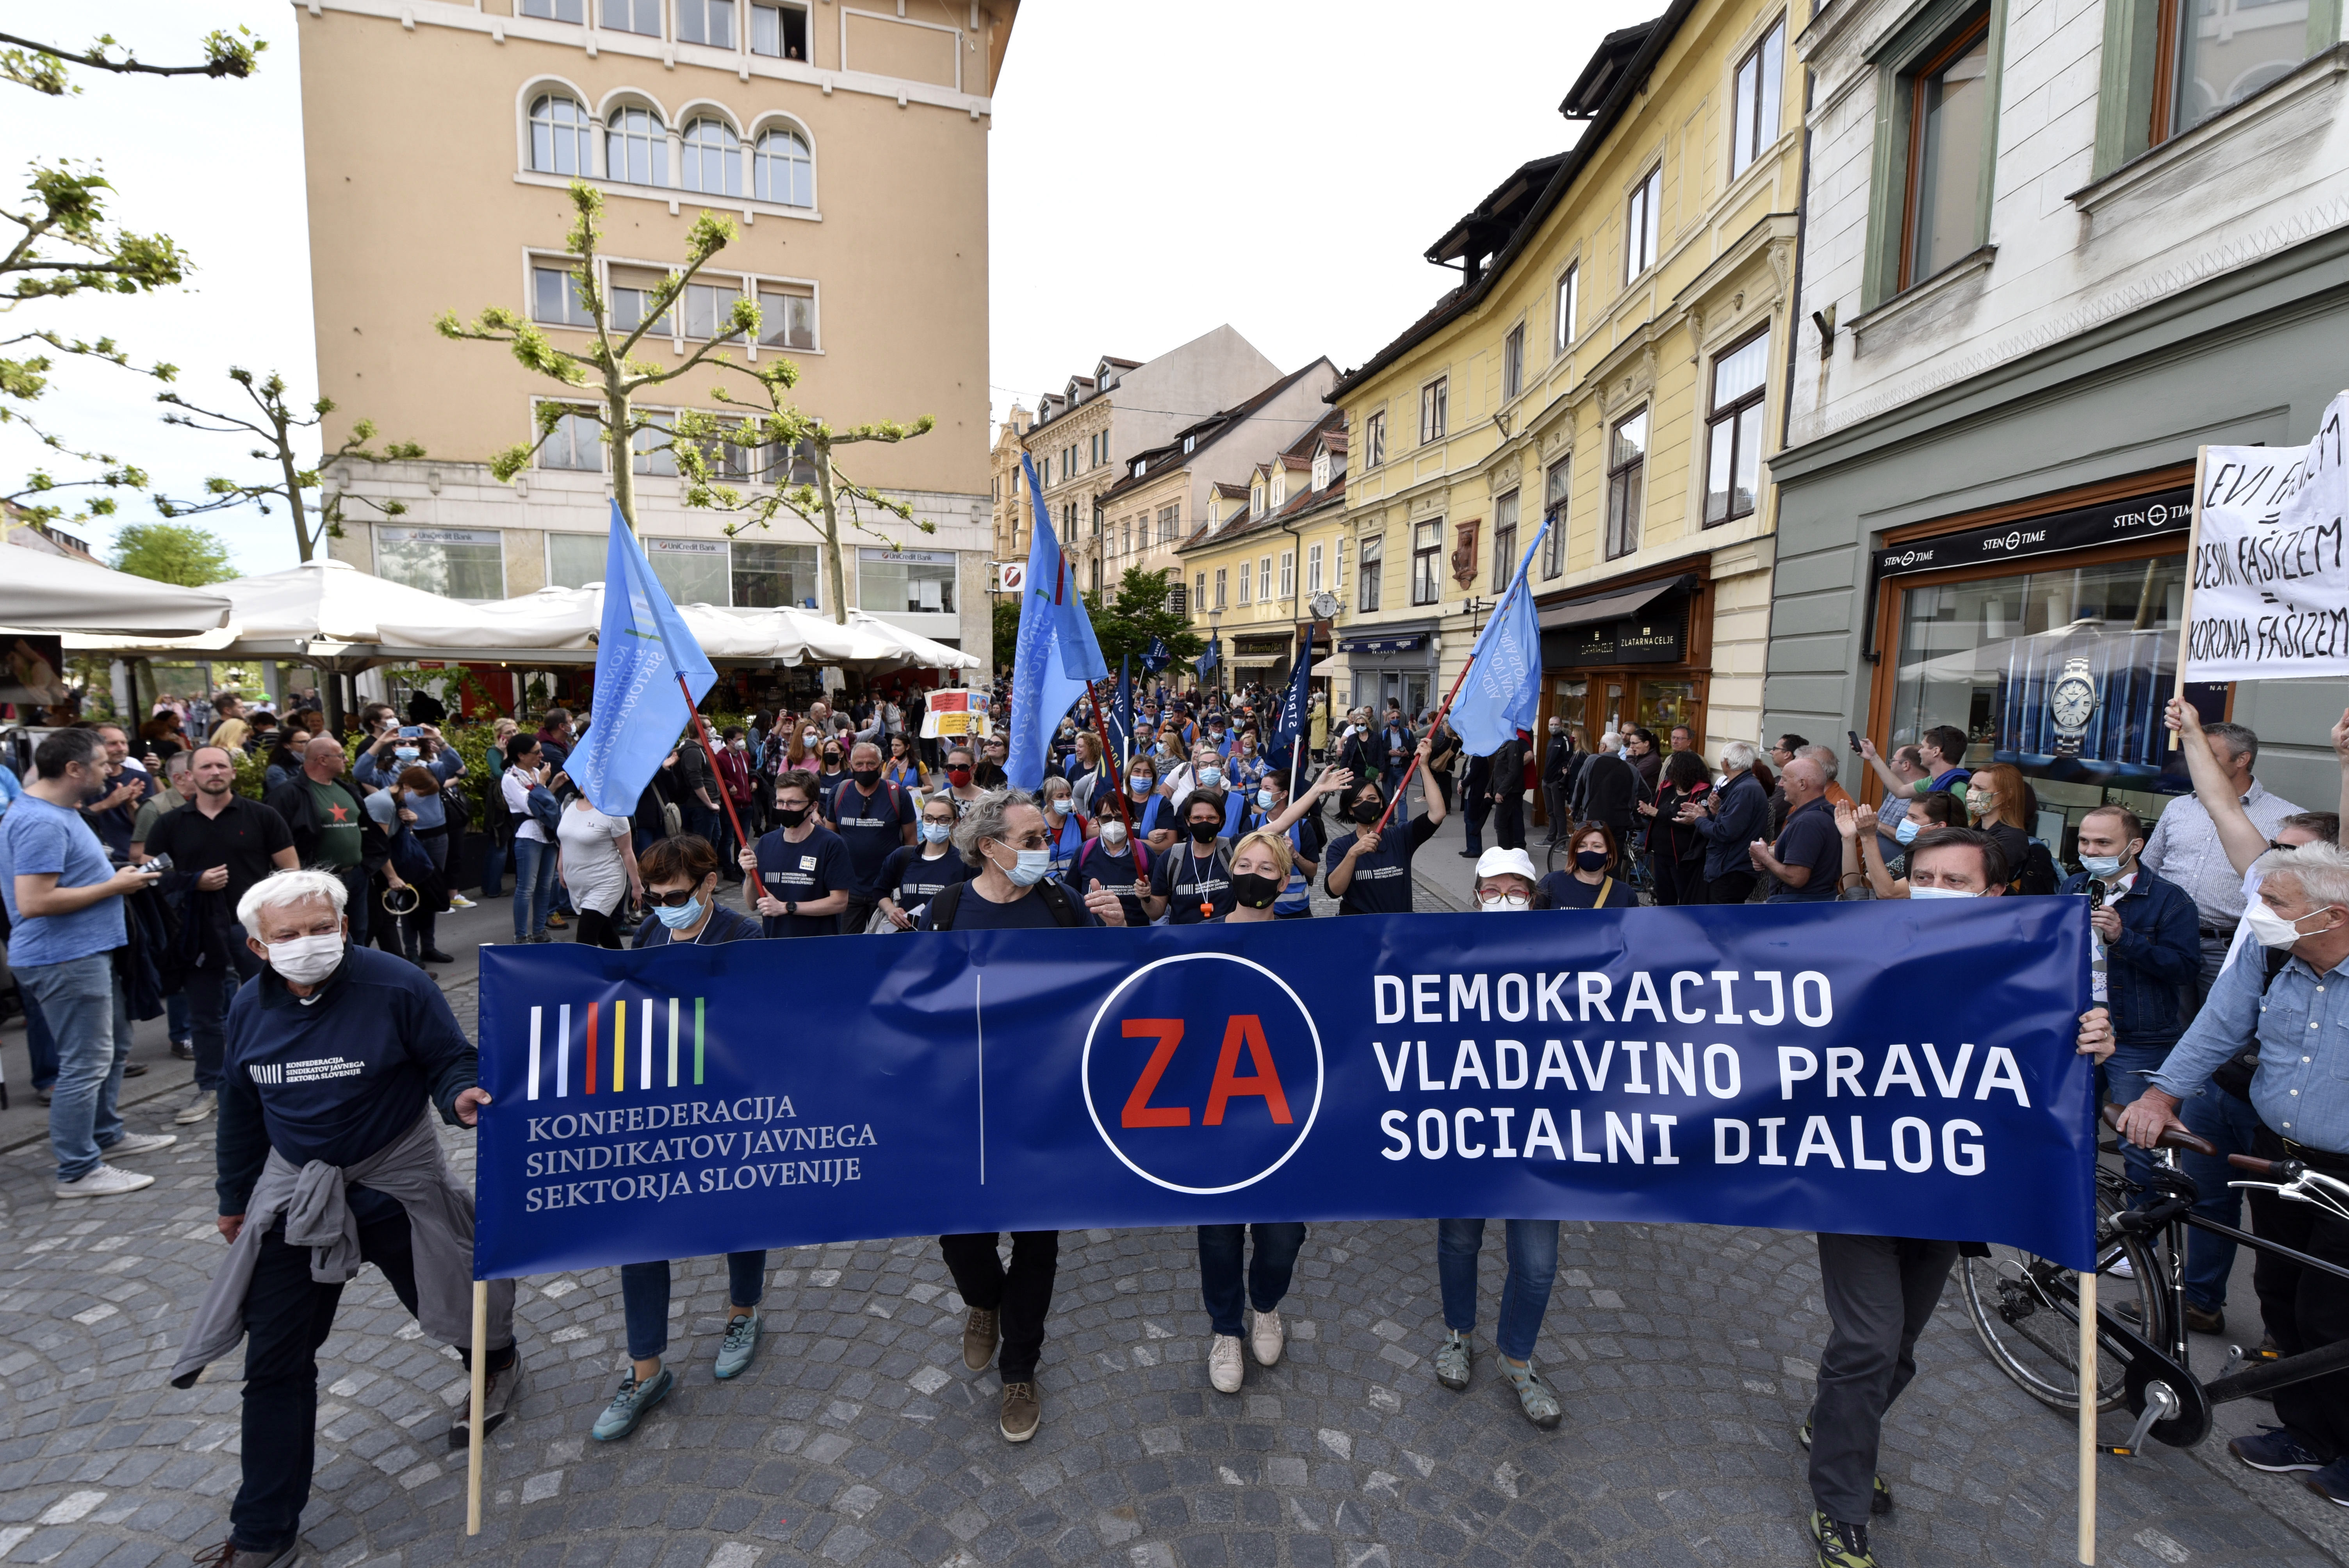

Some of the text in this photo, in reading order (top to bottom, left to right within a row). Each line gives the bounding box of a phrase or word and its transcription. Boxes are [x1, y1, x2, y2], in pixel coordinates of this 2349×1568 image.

[2201, 463, 2274, 510] EVI
[2113, 504, 2194, 529] STEN TIM
[1884, 550, 1934, 567] STEN TIME
[1983, 530, 2046, 551] STEN TIME
[2194, 517, 2342, 590] DESNI FAŠIZEM
[1153, 641, 1162, 656] KOVNI
[1582, 642, 1613, 654] ZLATARNA CELJE
[1621, 636, 1674, 647] ZLATARNA CELJE
[2188, 603, 2349, 662] KORONA FAŠIZEM
[1374, 971, 1832, 1027] DEMOKRACIJO
[286, 1057, 344, 1069] KONFEDERACIJA
[286, 1061, 365, 1076] SINDIKATOV JAVNEGA
[286, 1069, 361, 1083] SEKTORJA SLOVENIJE
[1121, 1014, 1293, 1128] ZA
[1372, 1040, 2030, 1108] VLADAVINO PRAVA
[527, 1096, 797, 1142] KONFEDERACIJA
[1381, 1108, 1985, 1175] SOCIALNI DIALOG
[527, 1124, 877, 1177] SINDIKATOV JAVNEGA
[526, 1157, 861, 1212] SEKTORJA SLOVENIJE
